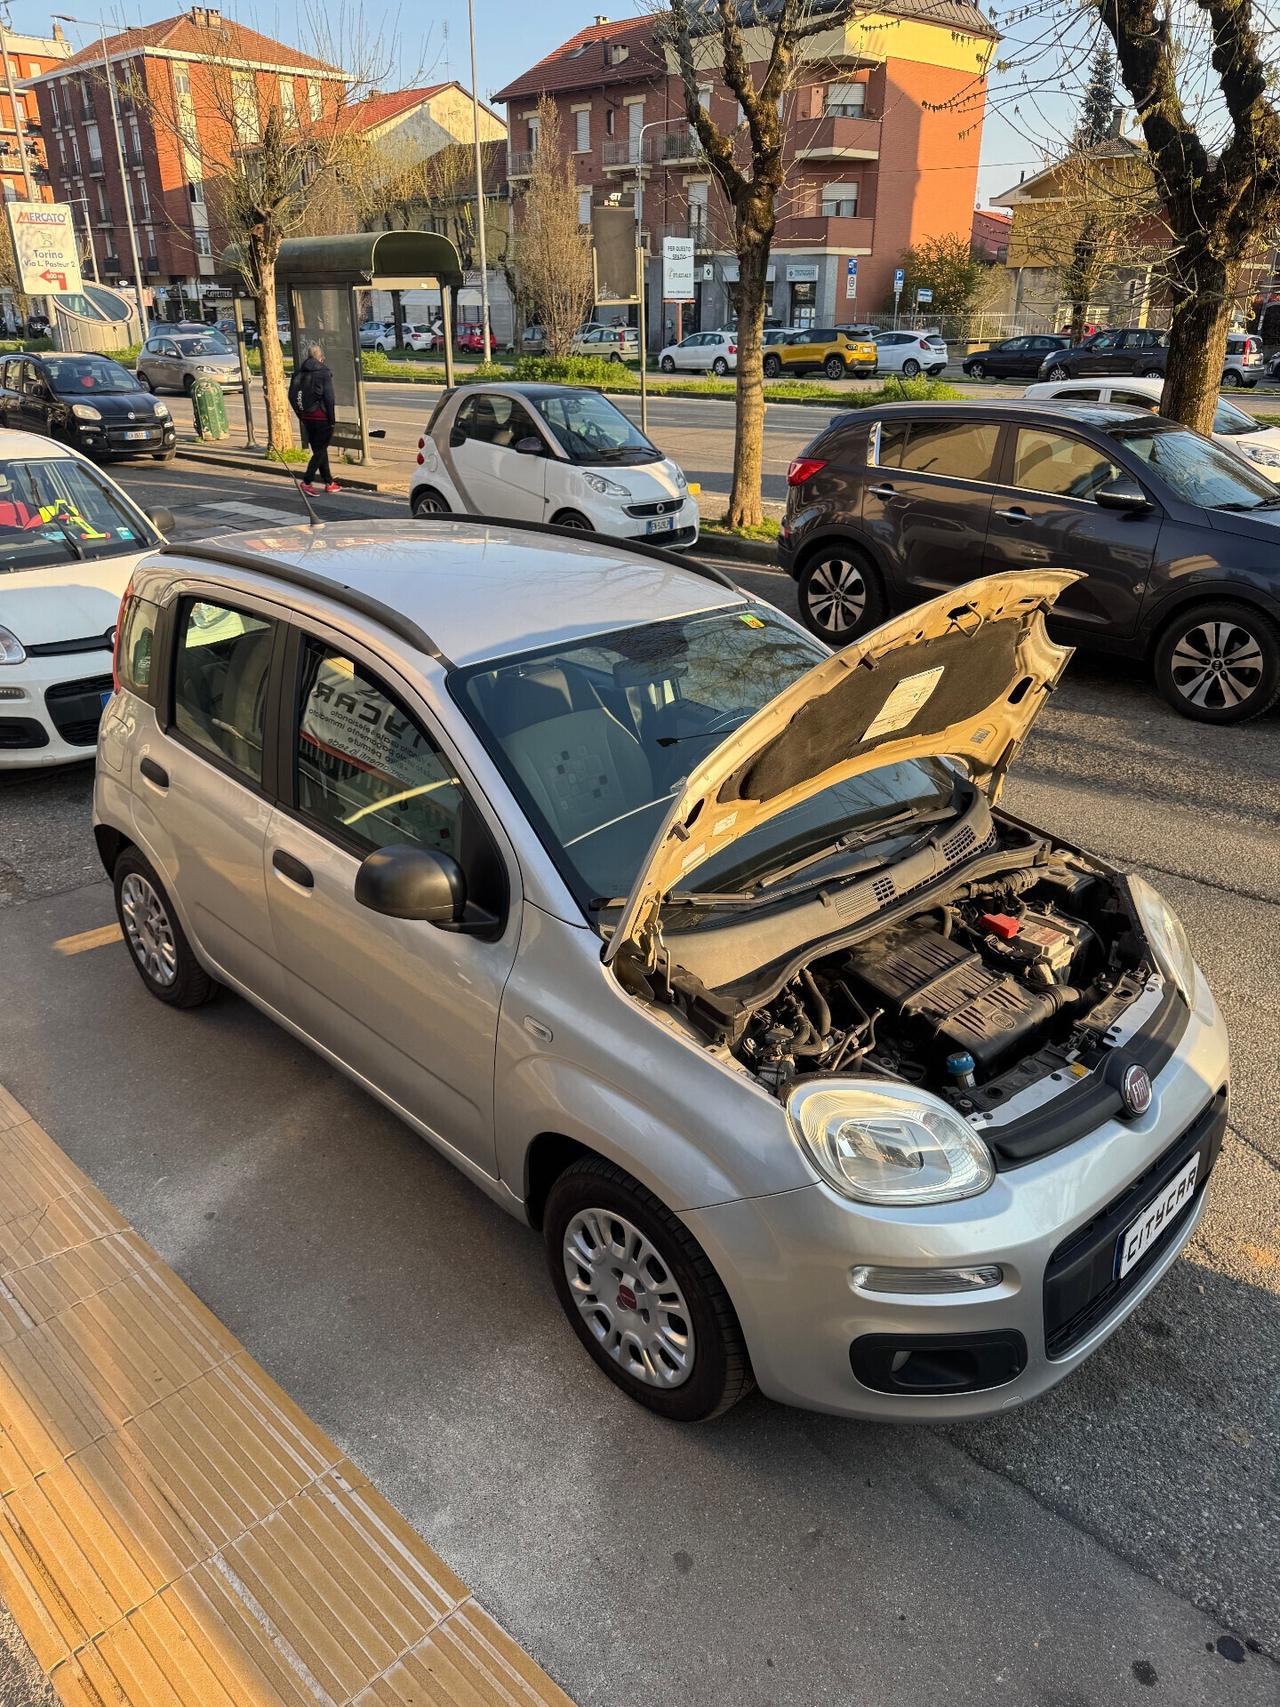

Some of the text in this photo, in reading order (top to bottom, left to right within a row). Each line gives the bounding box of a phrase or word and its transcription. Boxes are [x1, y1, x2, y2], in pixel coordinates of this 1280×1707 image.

[33, 250, 64, 259] Torino
[896, 271, 903, 280] P
[1131, 1075, 1149, 1105] FIAT
[1127, 1166, 1197, 1263] CITYCAR
